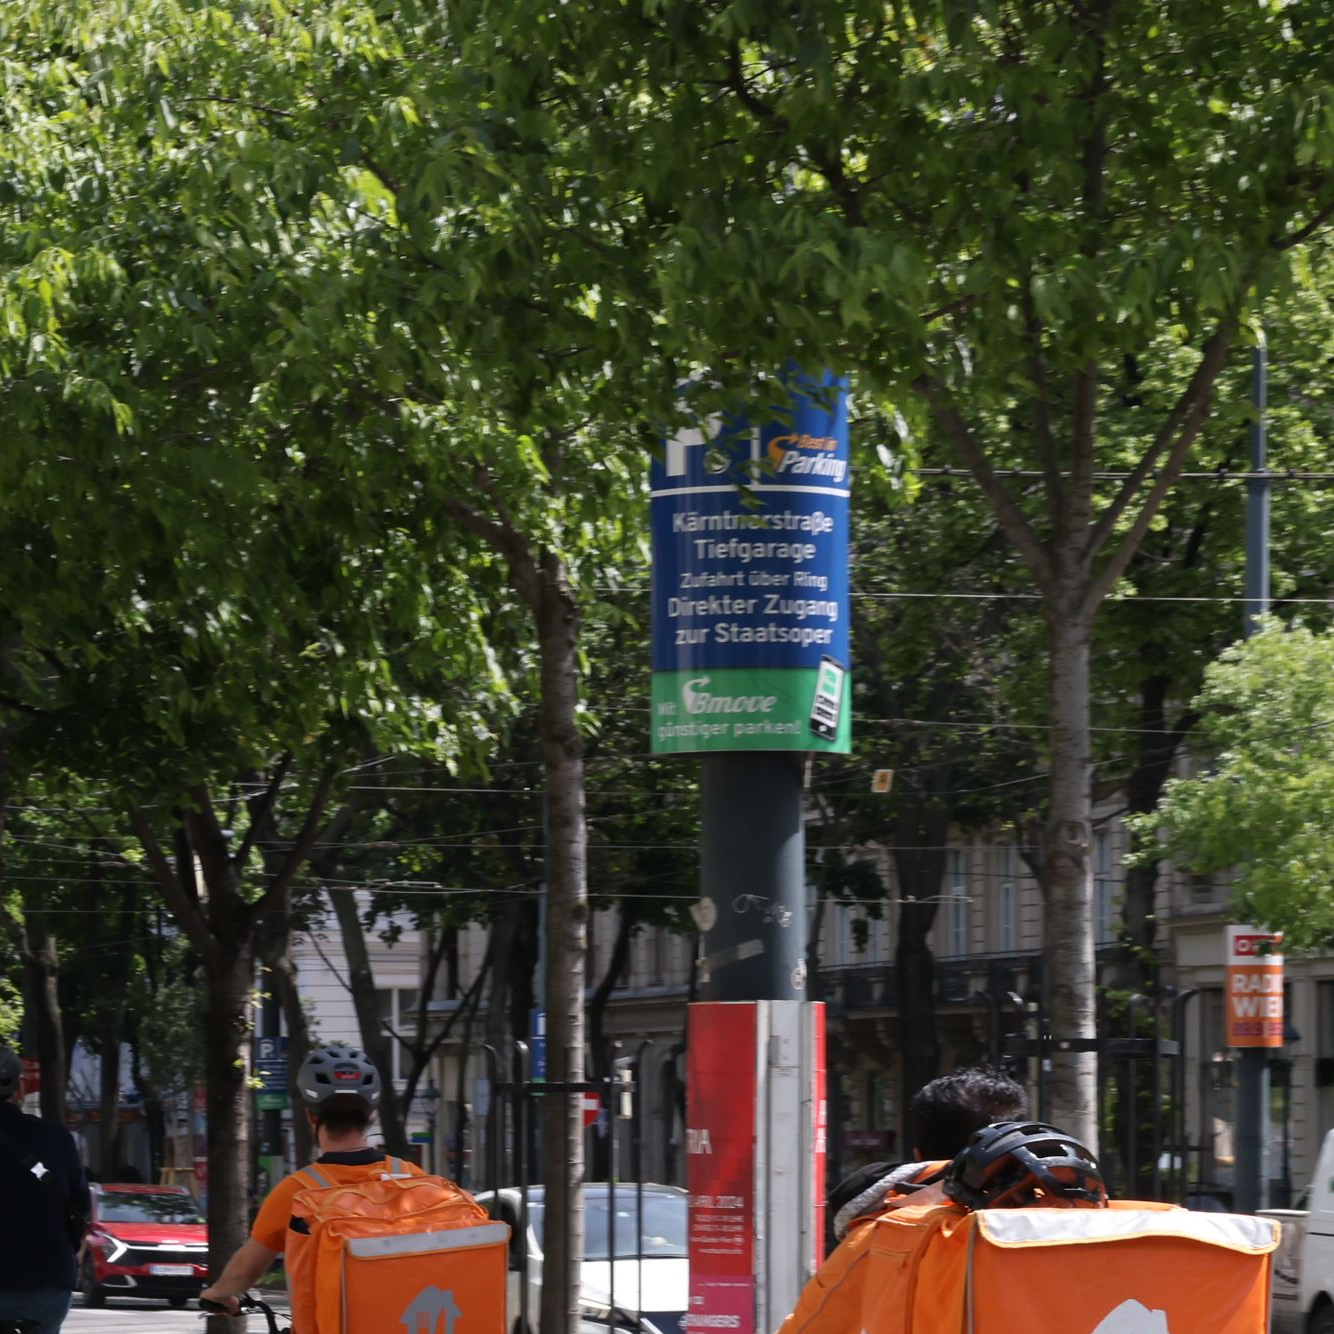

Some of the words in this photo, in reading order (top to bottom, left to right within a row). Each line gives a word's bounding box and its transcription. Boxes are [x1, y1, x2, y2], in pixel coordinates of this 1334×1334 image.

[778, 450, 847, 483] Parking
[693, 538, 817, 563] Tiefgarage
[680, 570, 745, 589] Zufahrt
[748, 570, 790, 587] über
[793, 571, 829, 592] Ring
[668, 595, 758, 618] Direkter
[763, 594, 839, 621] Zugang
[675, 628, 710, 645] zur
[714, 622, 834, 647] Staatsoper
